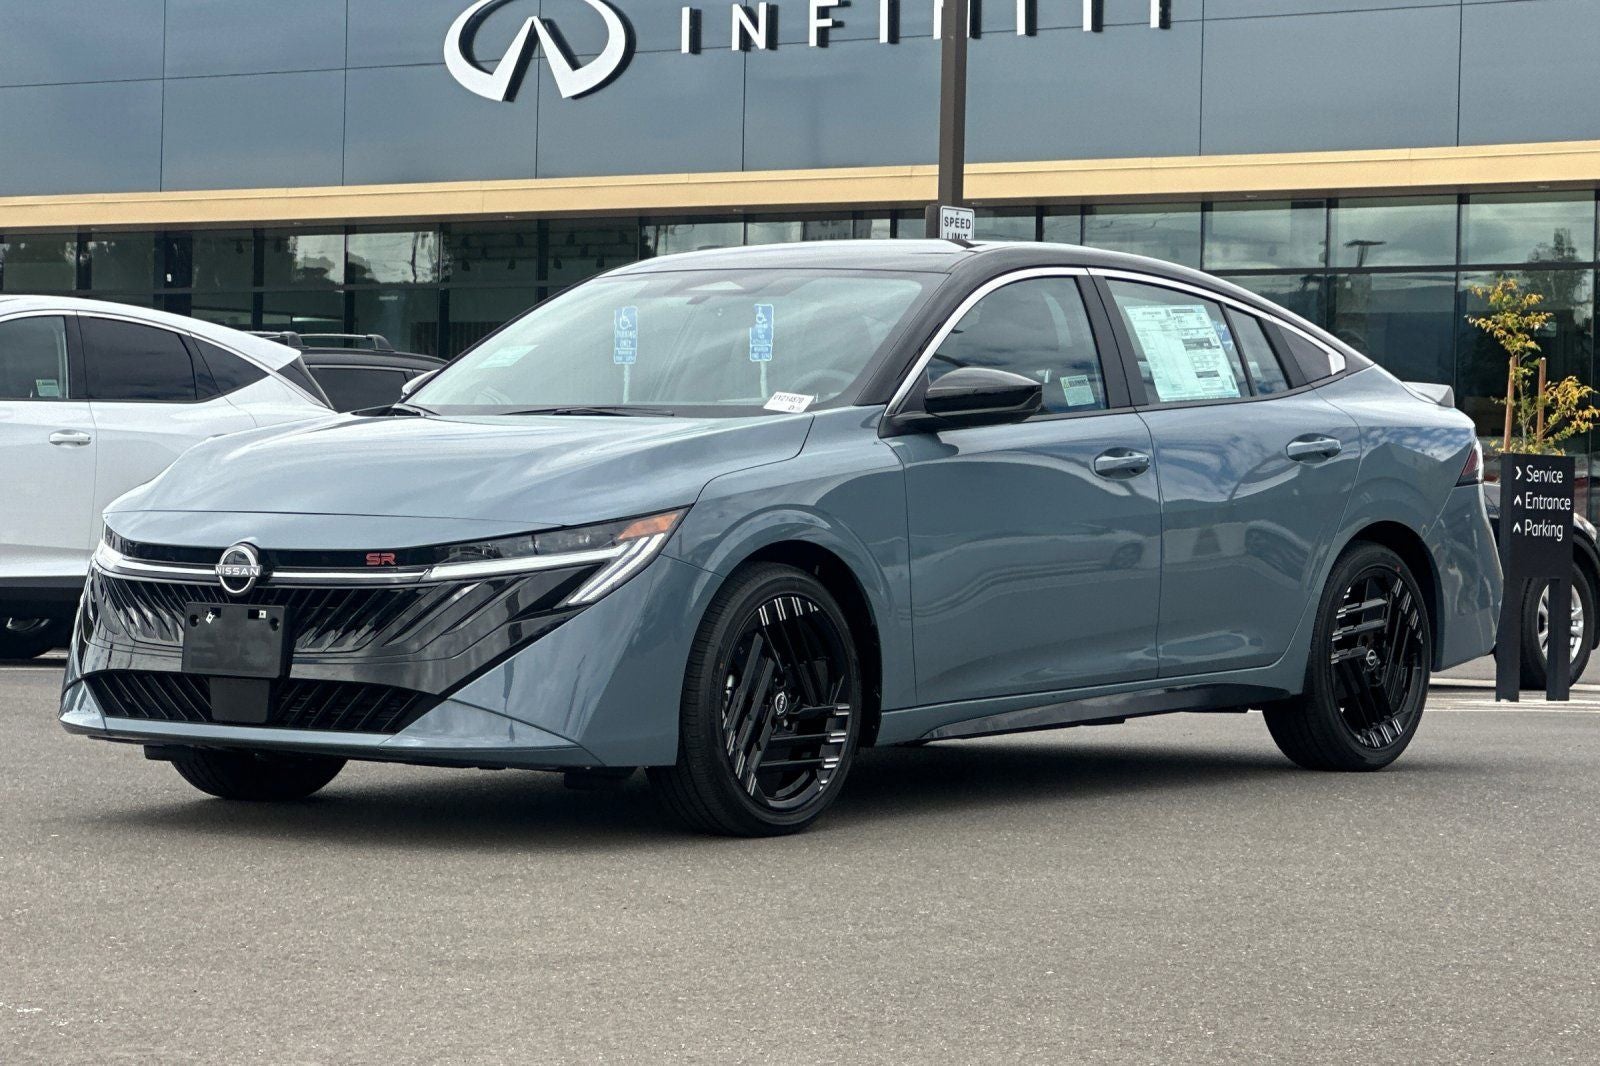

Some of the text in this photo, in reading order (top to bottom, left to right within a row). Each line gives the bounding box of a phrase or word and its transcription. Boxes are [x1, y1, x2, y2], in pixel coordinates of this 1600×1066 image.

[681, 0, 1160, 54] INFIII
[944, 216, 971, 230] SPEED
[1526, 464, 1563, 483] Service
[1525, 491, 1571, 511] Entrance
[1524, 519, 1564, 542] Parking
[366, 552, 396, 566] SR
[215, 566, 260, 576] NISSAN
